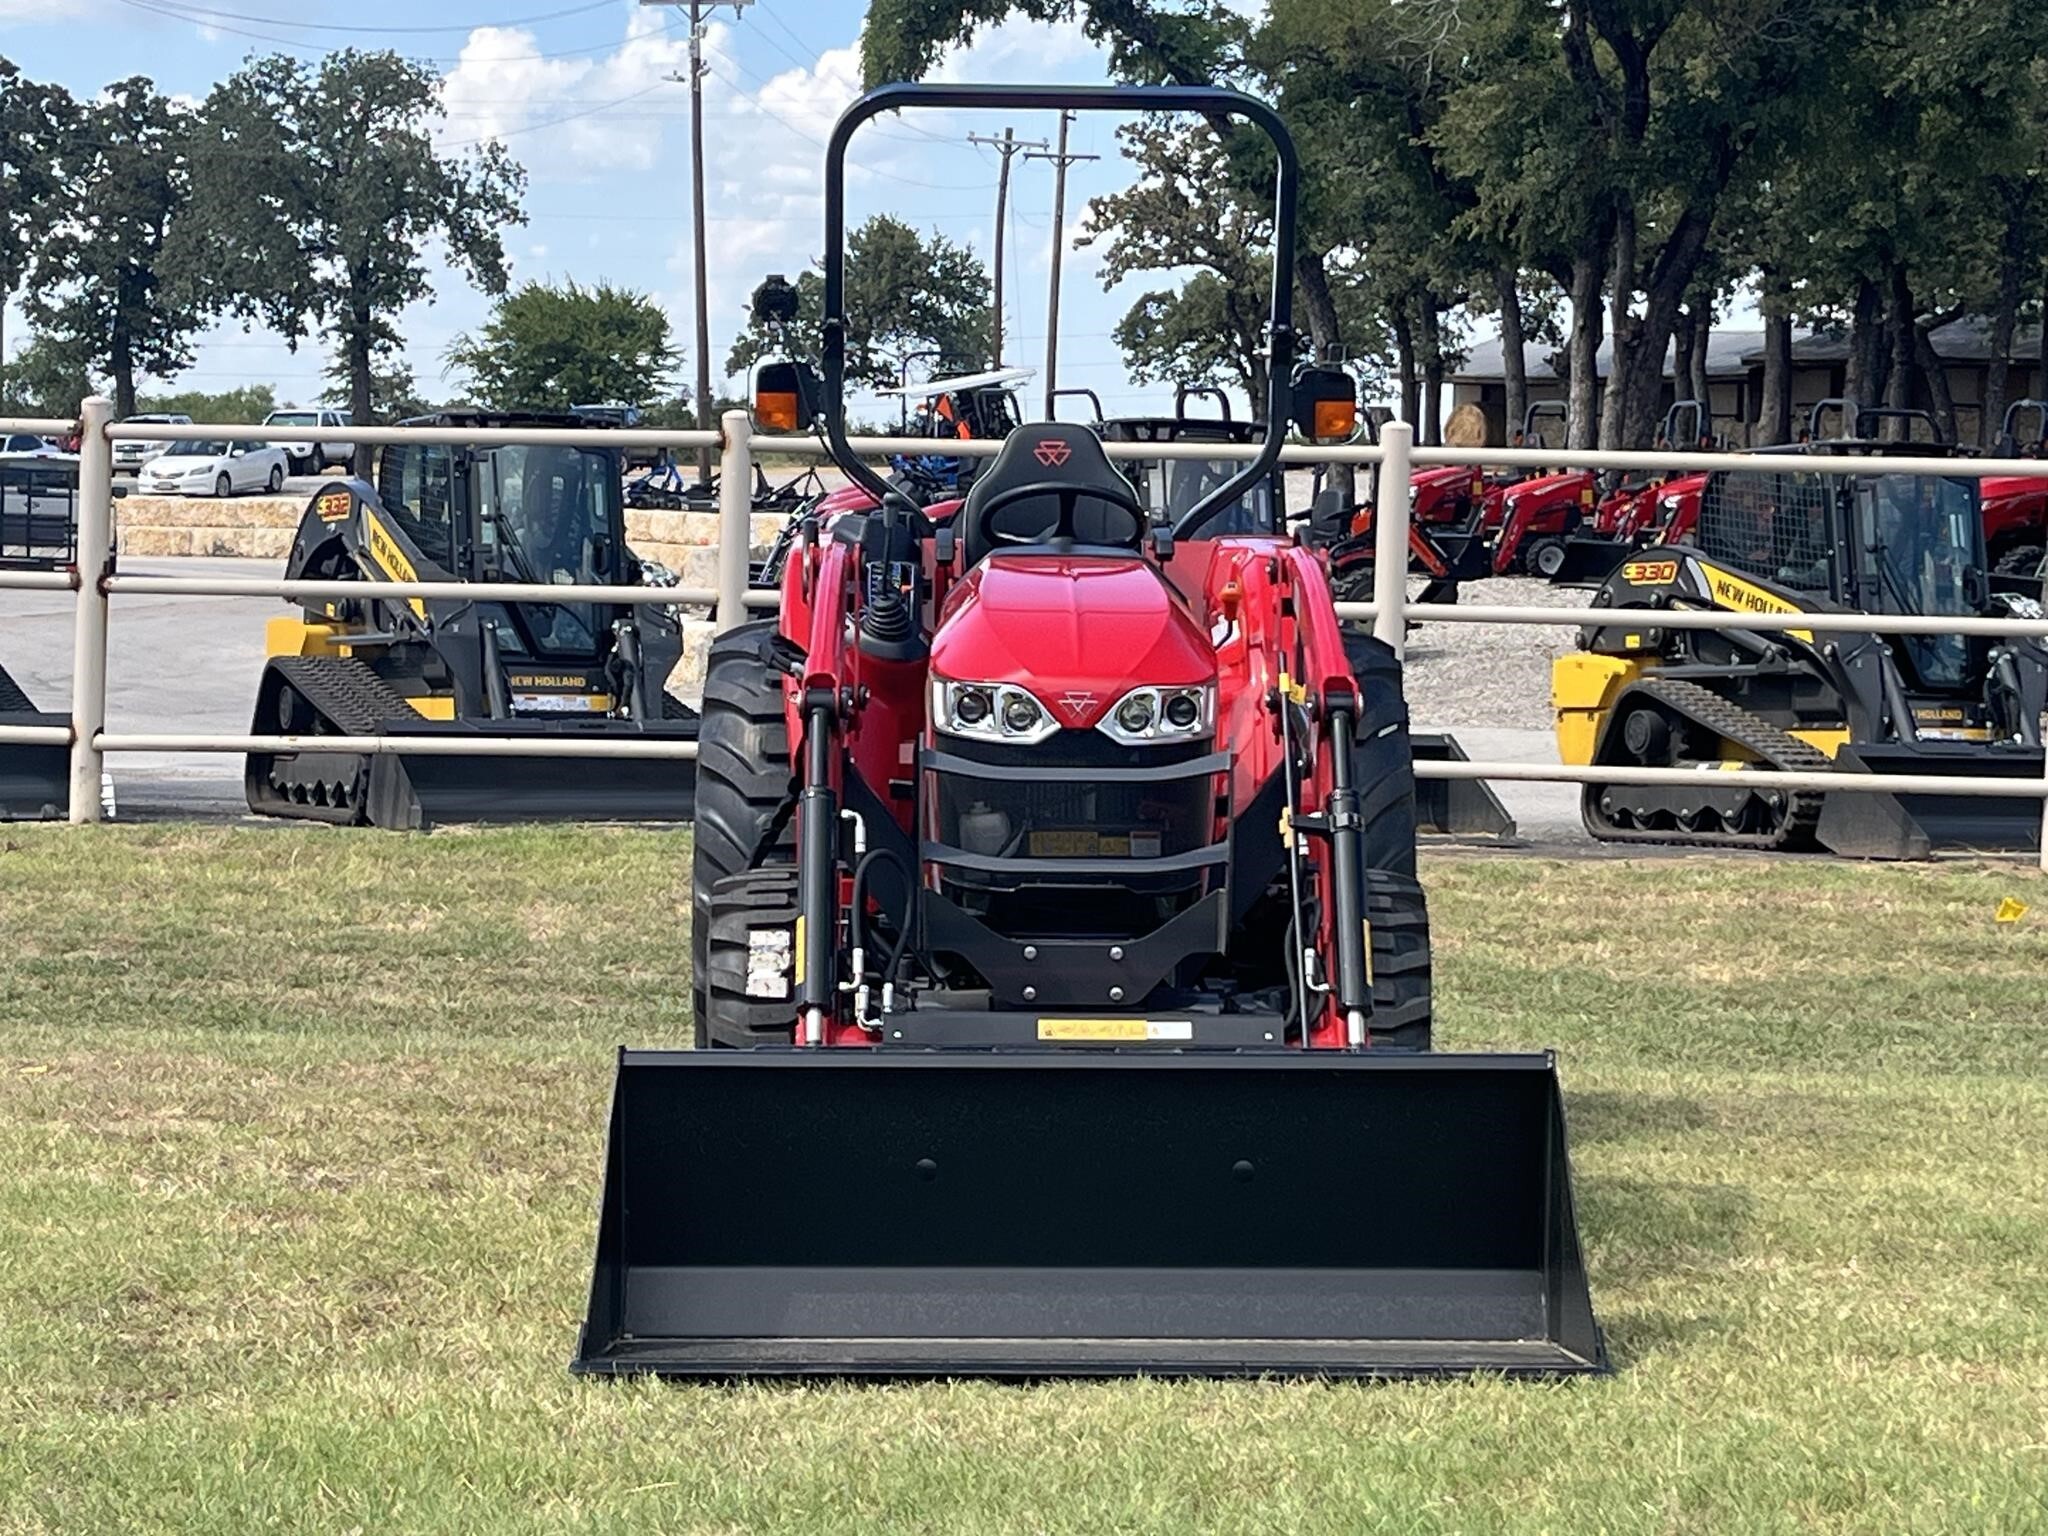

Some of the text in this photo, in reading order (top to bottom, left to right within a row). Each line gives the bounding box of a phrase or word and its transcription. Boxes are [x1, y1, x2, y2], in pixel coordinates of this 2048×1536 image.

[1623, 562, 1677, 584] C330
[1716, 579, 1745, 604] NEW
[534, 675, 587, 688] HOLLAND
[1916, 708, 1963, 720] HOLLAND
